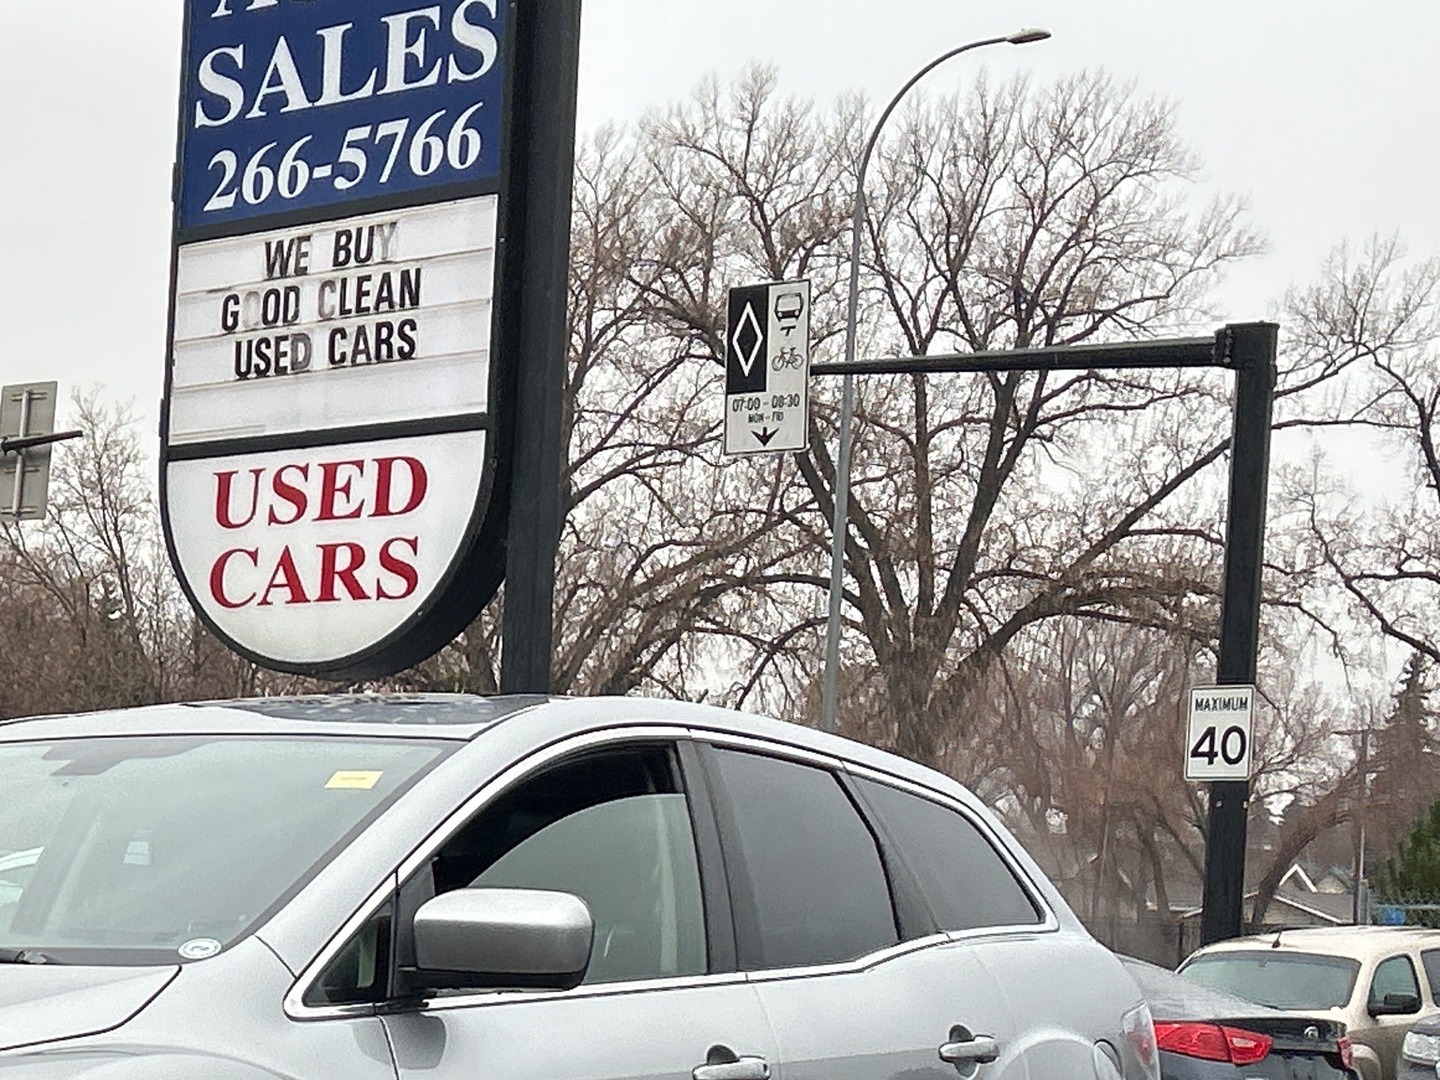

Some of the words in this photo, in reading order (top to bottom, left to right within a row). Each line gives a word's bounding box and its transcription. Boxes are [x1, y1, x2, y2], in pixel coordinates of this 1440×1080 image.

[195, 1, 499, 128] SALES
[204, 102, 484, 211] 266-5766
[265, 235, 312, 278] WE
[332, 222, 397, 267] BUY
[222, 285, 300, 332] GOOD
[318, 268, 421, 319] CLEAN
[234, 333, 311, 379] USED
[328, 318, 417, 366] CARS
[213, 456, 429, 529] USED
[209, 537, 419, 608] CARS
[1195, 697, 1248, 711] MAXIMUM
[1190, 725, 1247, 766] 40
